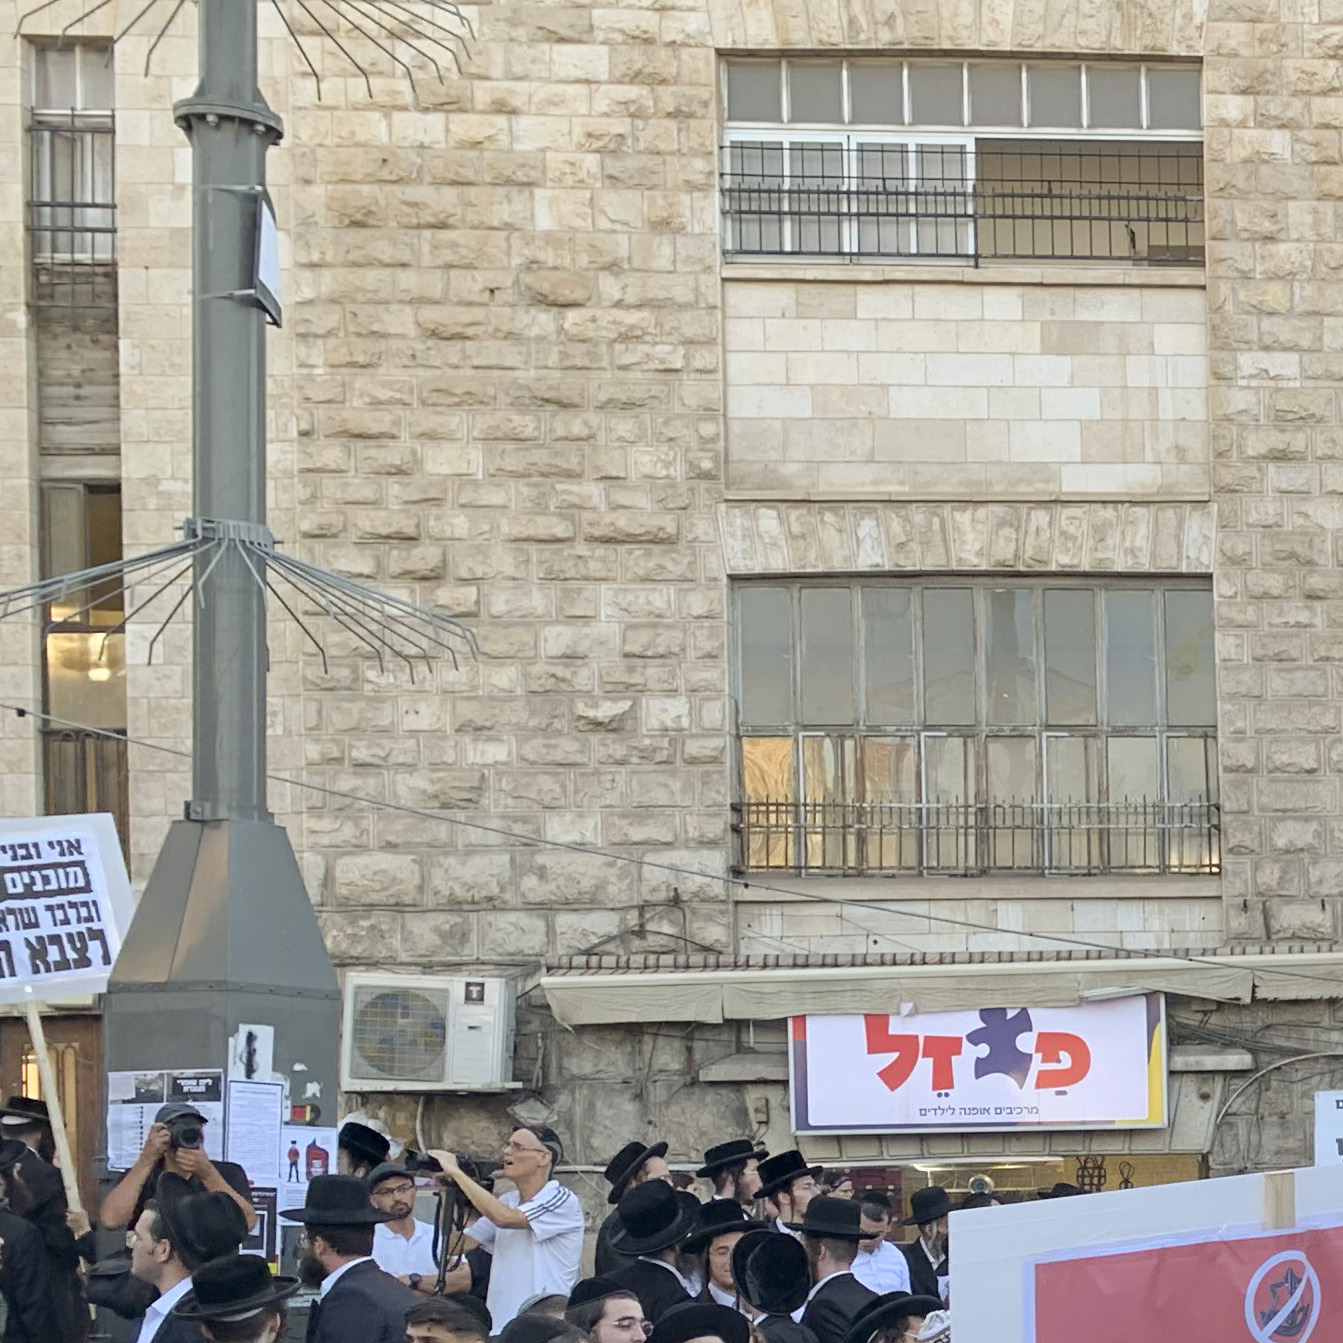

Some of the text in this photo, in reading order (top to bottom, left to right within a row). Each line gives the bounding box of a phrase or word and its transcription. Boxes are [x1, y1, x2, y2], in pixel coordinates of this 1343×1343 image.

[47, 838, 84, 857] אני
[3, 866, 86, 894] מוכנים
[44, 900, 101, 927] ובלבד
[24, 927, 112, 975] לצבא
[919, 1104, 1039, 1117] מרכיבים אופנה לילדים
